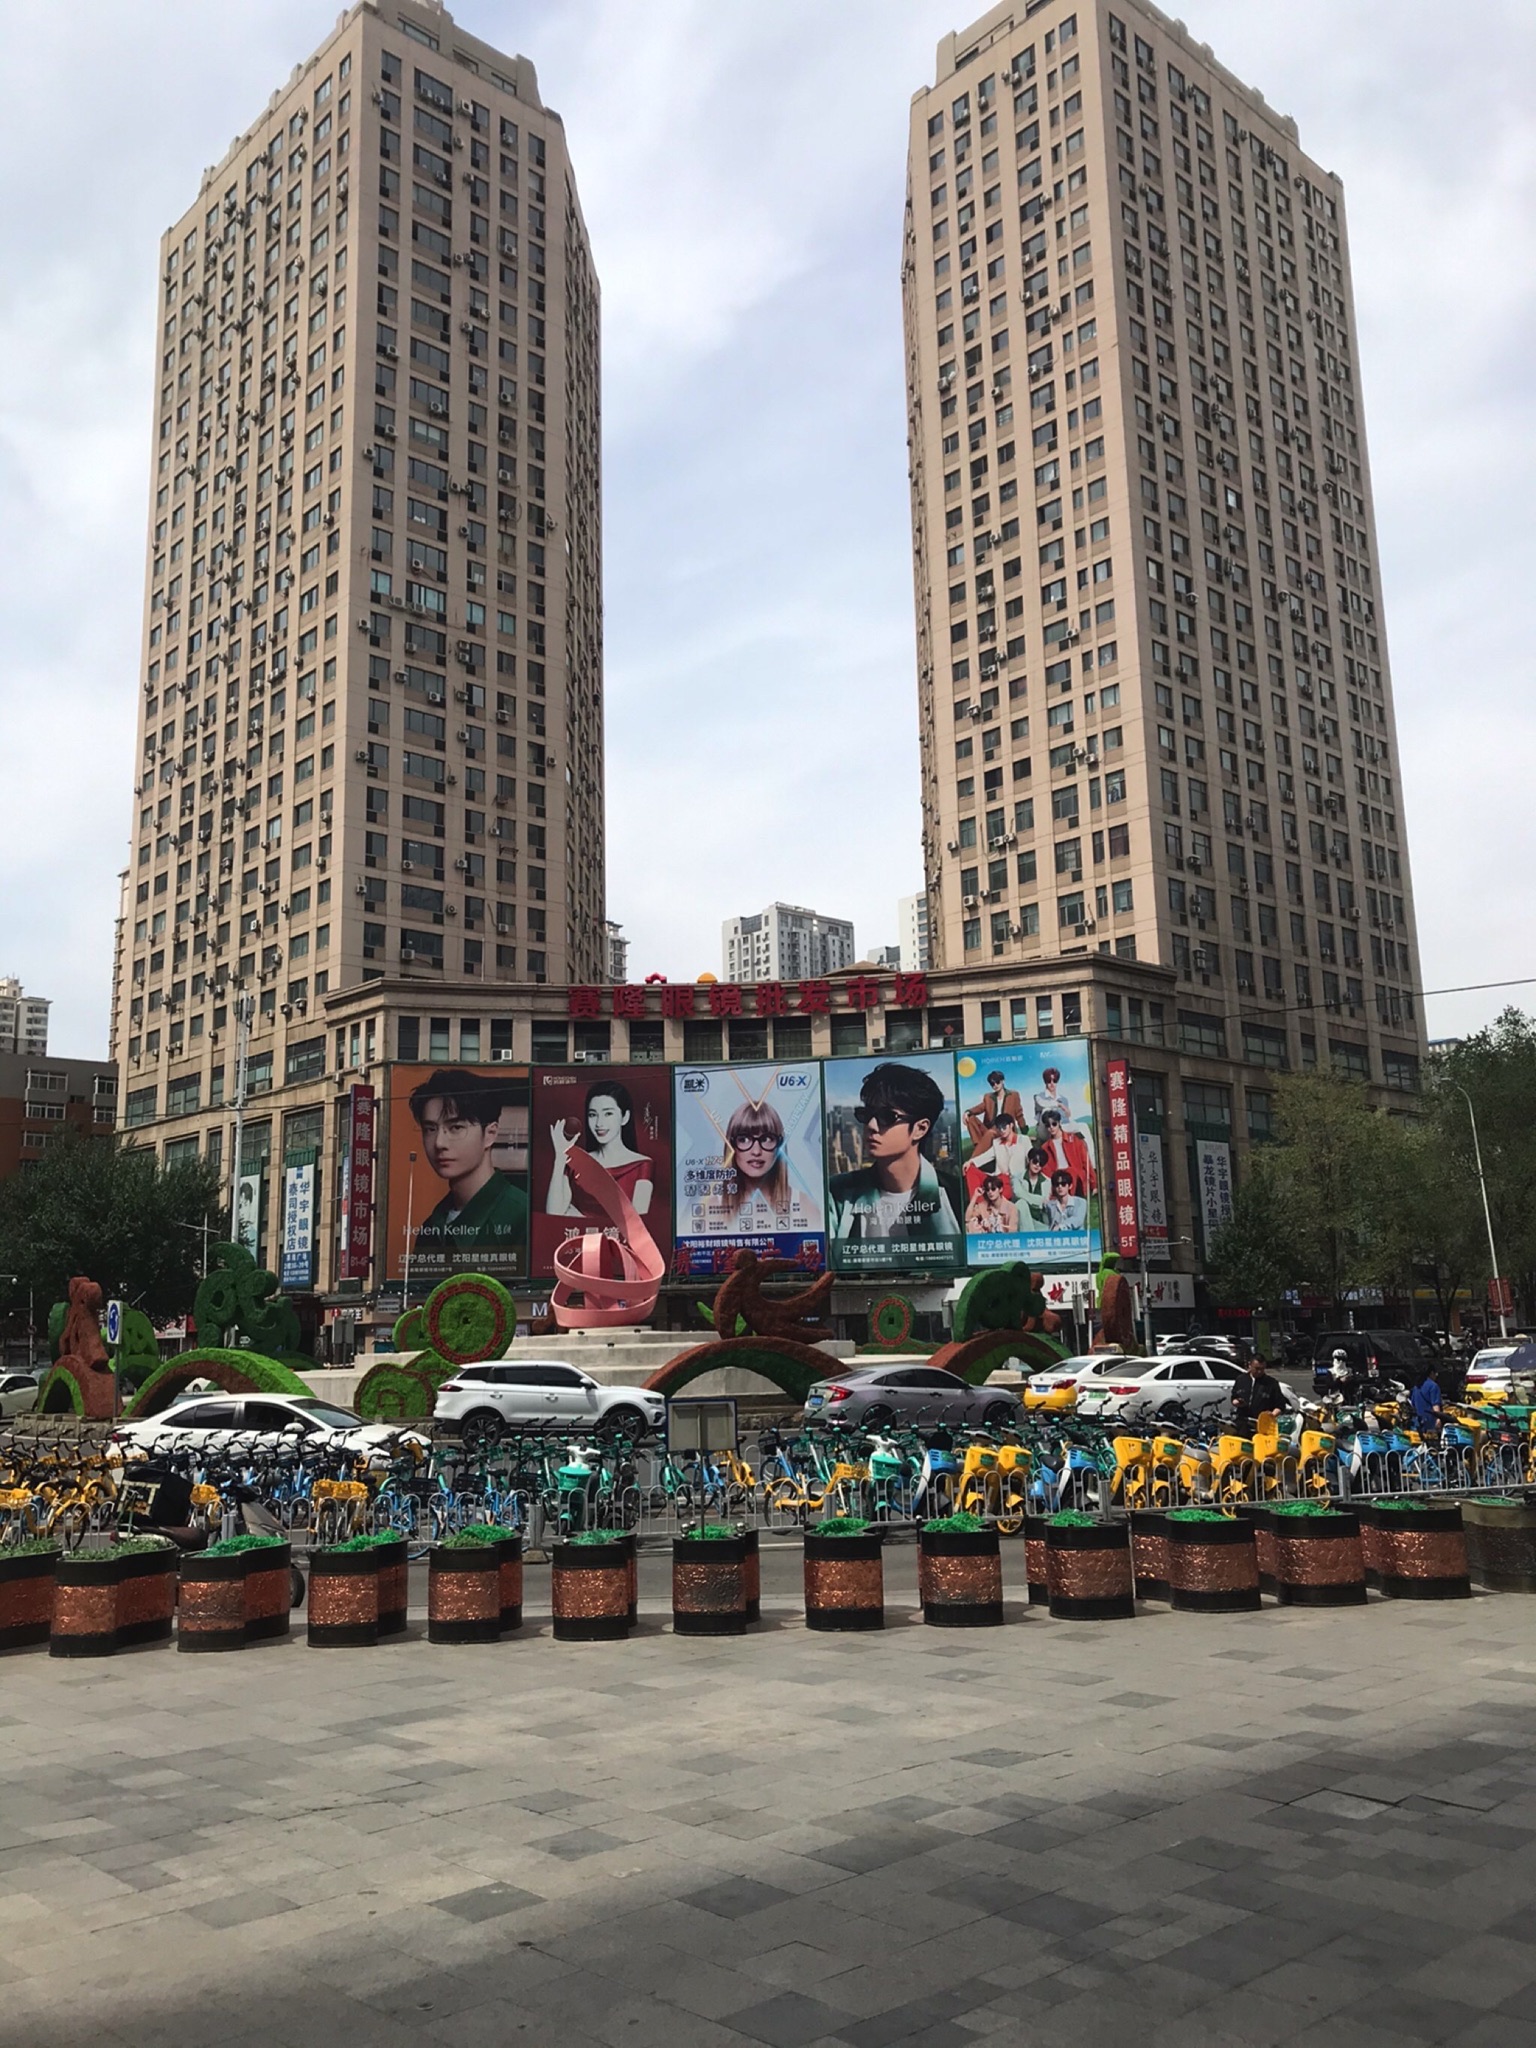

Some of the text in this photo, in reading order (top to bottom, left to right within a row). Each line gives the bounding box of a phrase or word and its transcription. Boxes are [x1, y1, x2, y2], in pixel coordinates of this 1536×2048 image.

[567, 972, 928, 1020] 赛隆眼镜批发市场
[1109, 1070, 1135, 1226] 赛隆精品眼镜
[352, 1096, 372, 1246] 赛隆眼镜市场
[685, 1168, 737, 1182] 多维度防护
[853, 1200, 936, 1214] Helen Keller
[297, 1180, 310, 1250] 华宇眼镜
[443, 1223, 481, 1236] Keller
[977, 1238, 1021, 1250] 辽宁总代理
[1121, 1235, 1136, 1247] 5F
[842, 1244, 886, 1255] 辽宁总代理
[398, 1253, 446, 1264] 辽宁总代理
